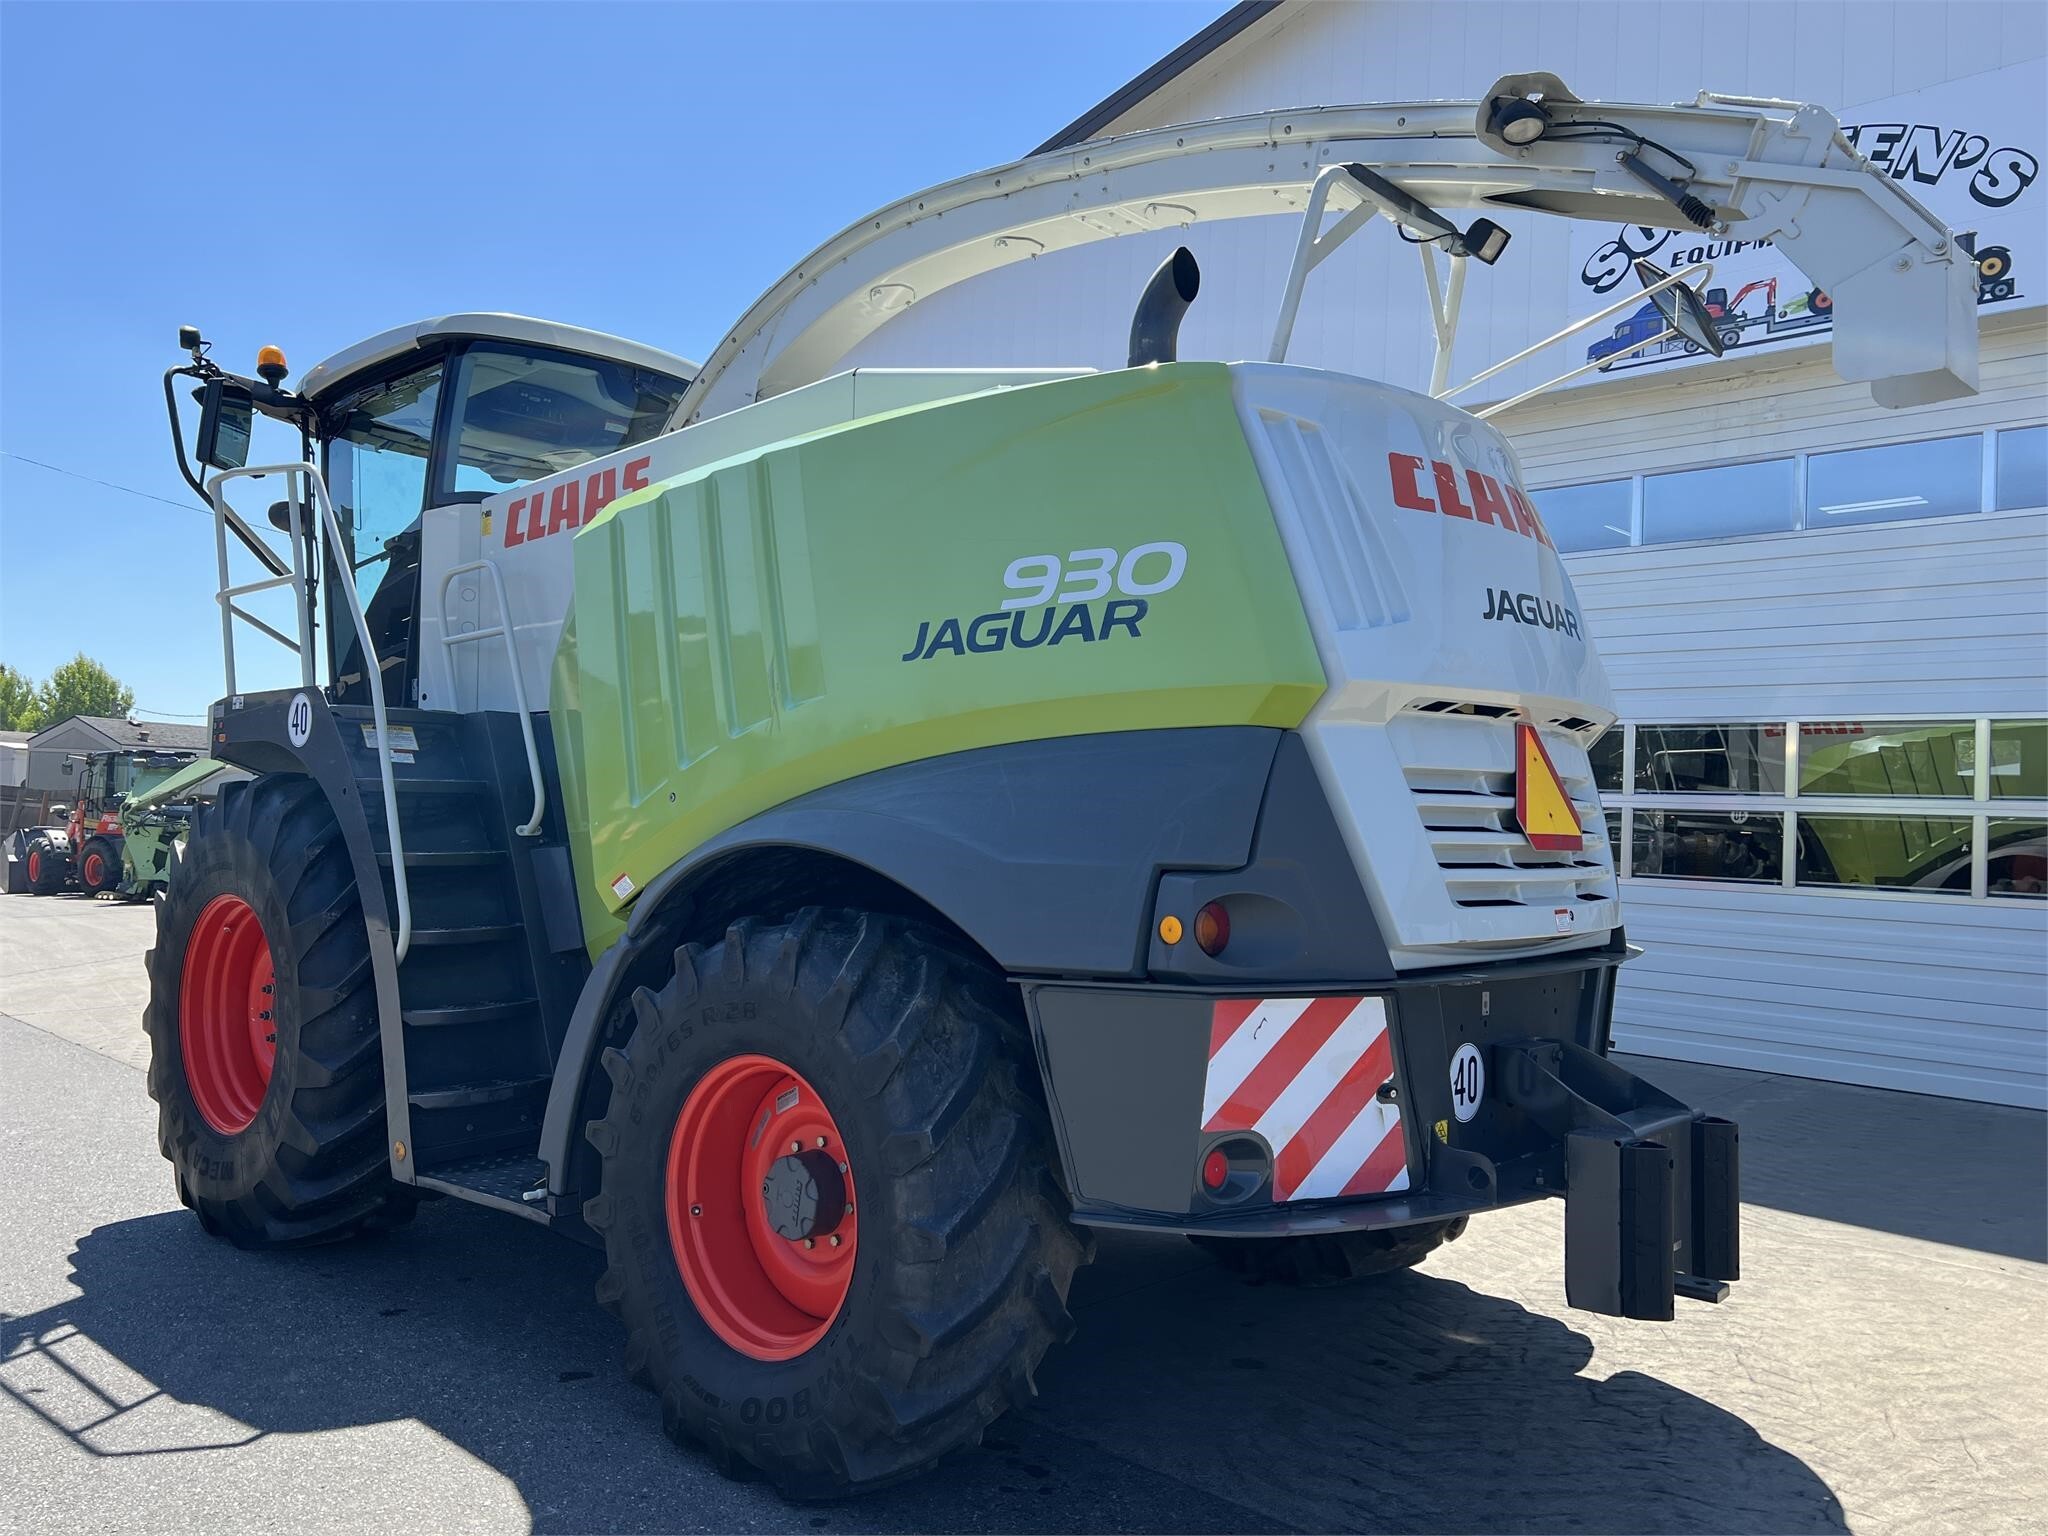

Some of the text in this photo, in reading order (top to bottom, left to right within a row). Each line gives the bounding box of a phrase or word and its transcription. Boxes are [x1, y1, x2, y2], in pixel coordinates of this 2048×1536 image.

[504, 456, 651, 549] CLAAS
[1388, 452, 1555, 551] CLAA
[1000, 541, 1188, 610] 930
[902, 599, 1149, 662] JAGUAR
[1483, 588, 1581, 641] JAGUAR
[291, 702, 308, 736] 40
[1453, 1055, 1478, 1106] 40
